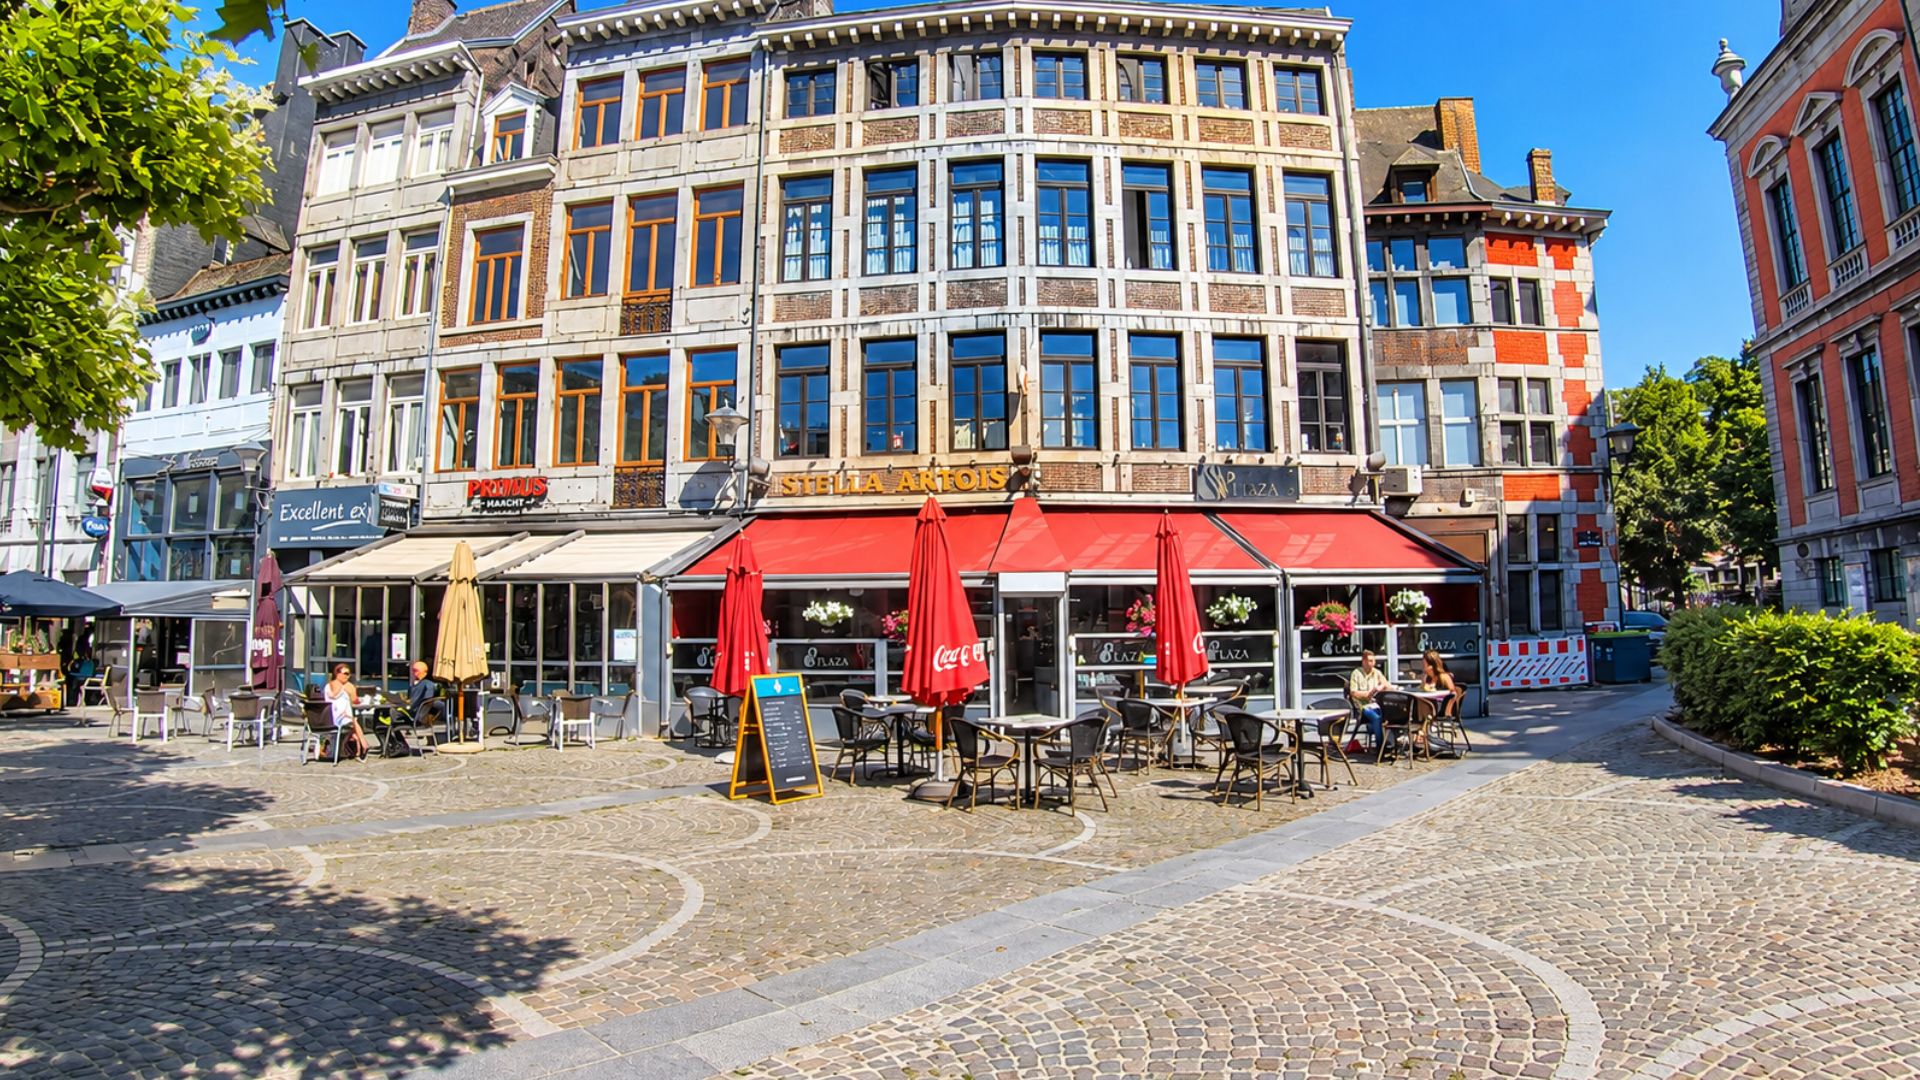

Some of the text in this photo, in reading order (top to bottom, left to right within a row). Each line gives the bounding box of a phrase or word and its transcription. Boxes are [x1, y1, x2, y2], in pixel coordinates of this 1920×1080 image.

[467, 476, 549, 498] PRIMUS
[782, 466, 1008, 496] STELLA ARTOIS
[280, 501, 344, 522] Excellent
[486, 499, 525, 508] HAACHT
